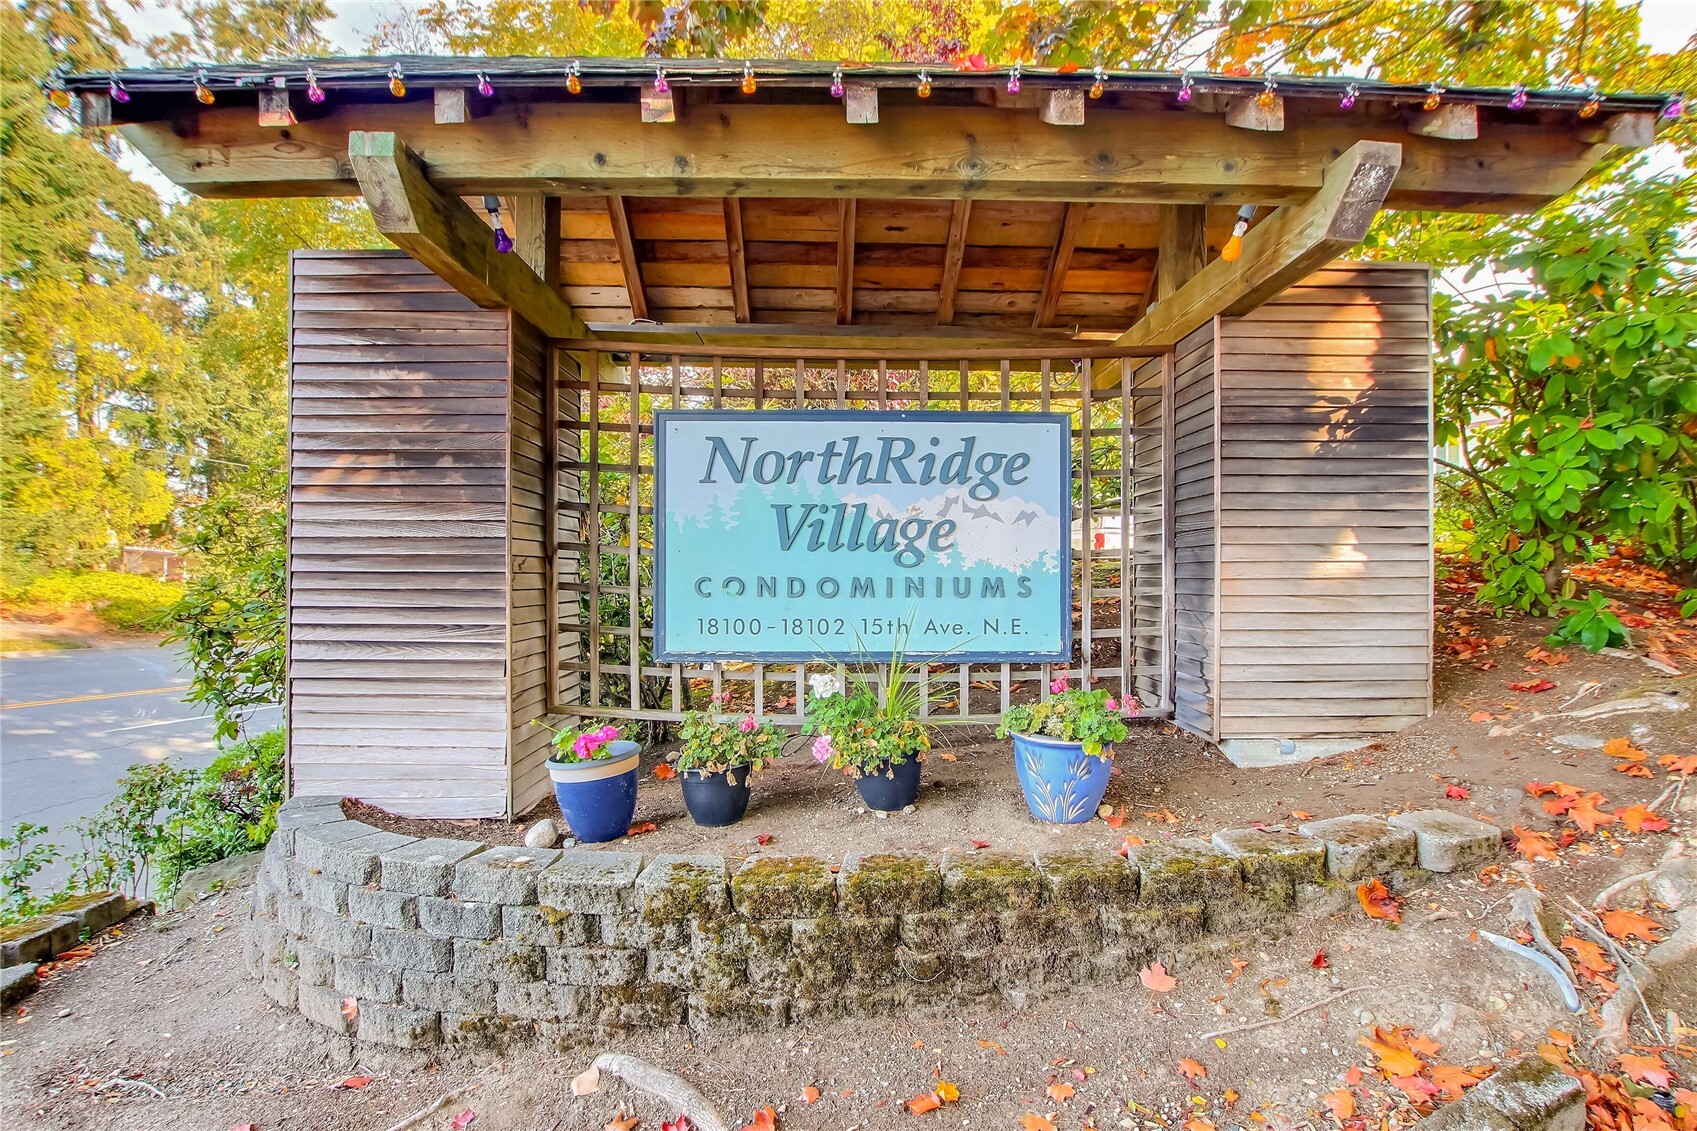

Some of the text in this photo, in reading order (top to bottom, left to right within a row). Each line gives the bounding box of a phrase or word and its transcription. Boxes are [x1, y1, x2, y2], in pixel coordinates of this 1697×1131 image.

[699, 435, 1031, 501] NorthRidge
[770, 502, 957, 568] Village
[694, 575, 1033, 599] CONDOMINIUMS
[861, 617, 910, 636] 15th
[923, 618, 972, 636] Ave.
[983, 618, 1030, 636] N.E.
